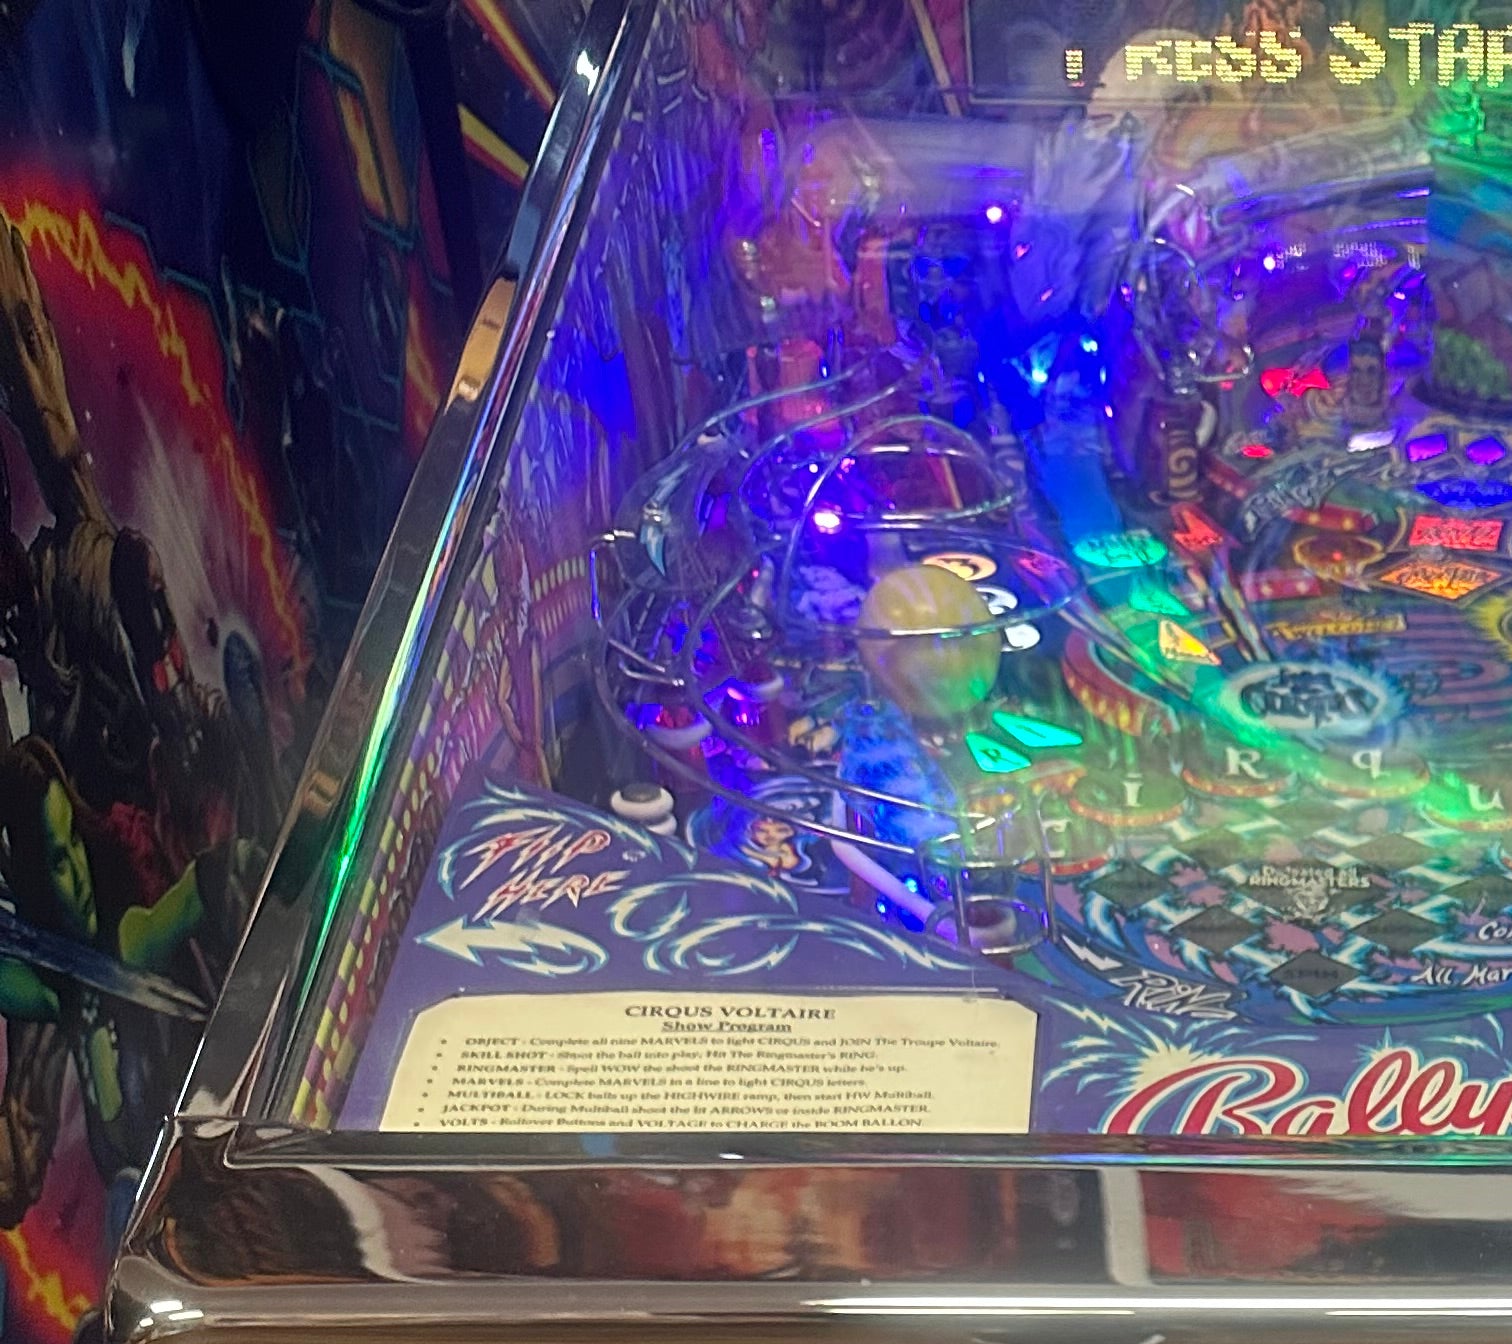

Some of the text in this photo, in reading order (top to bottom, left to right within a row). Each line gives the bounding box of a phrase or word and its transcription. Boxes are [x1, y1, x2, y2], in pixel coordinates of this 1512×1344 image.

[1410, 964, 1453, 986] All
[625, 1006, 836, 1020] CIRQUS VOLTAIRE
[662, 1021, 792, 1033] Show Program
